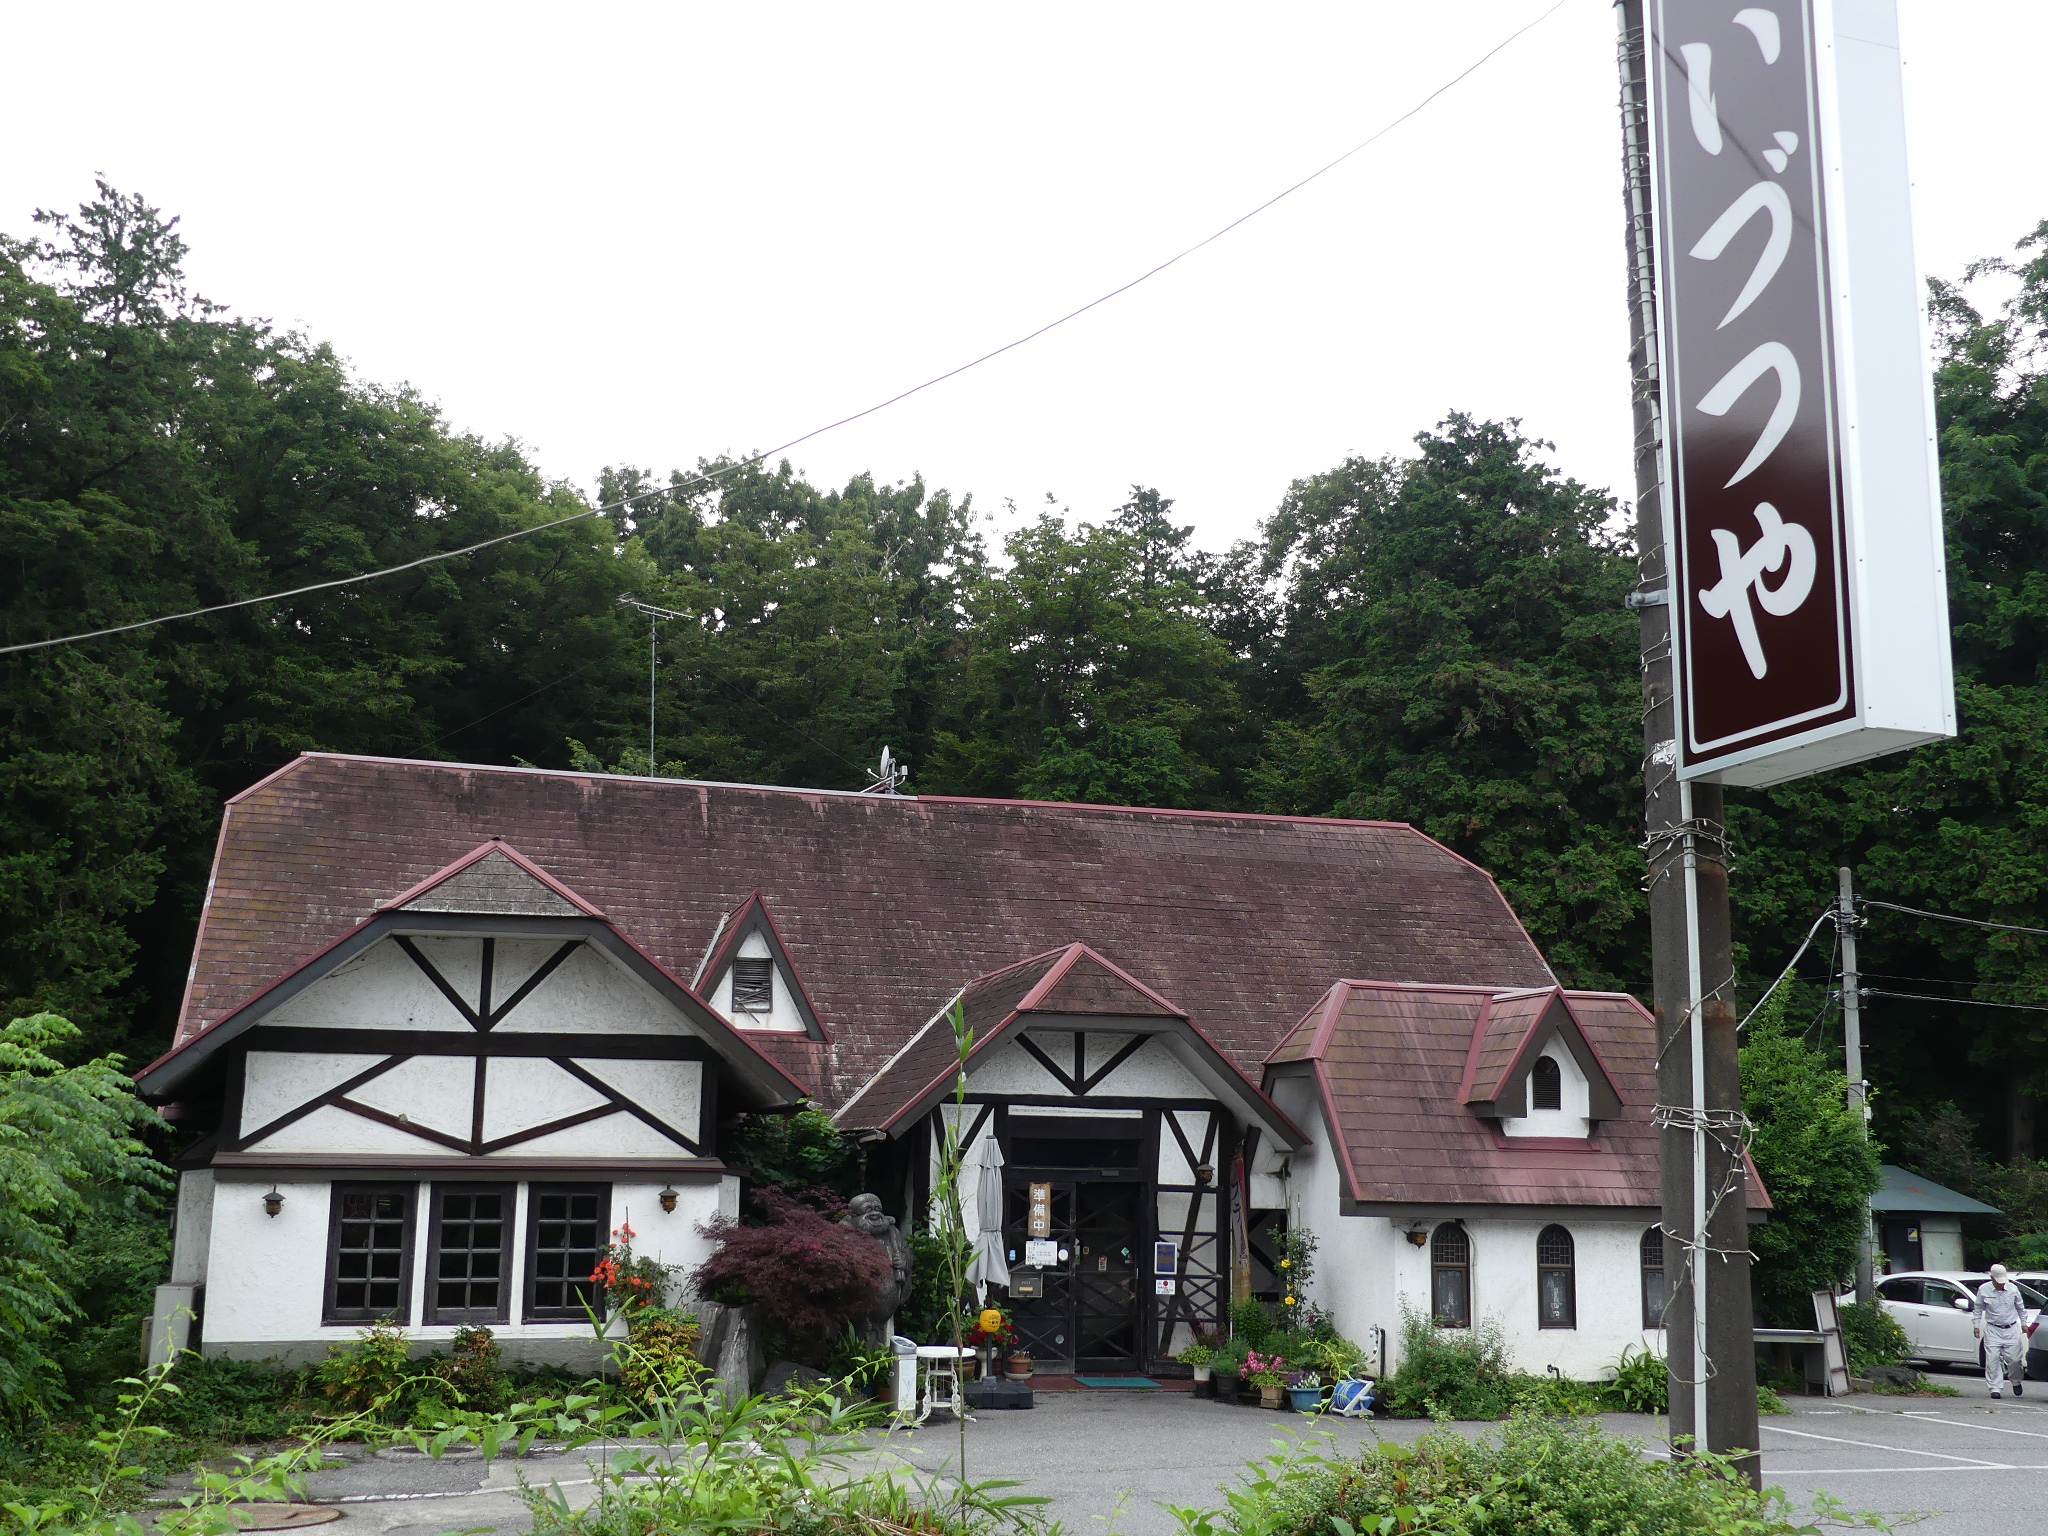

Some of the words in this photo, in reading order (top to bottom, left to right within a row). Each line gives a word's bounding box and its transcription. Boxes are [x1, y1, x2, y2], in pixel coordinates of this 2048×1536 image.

[1679, 7, 1817, 681] いづつや
[1033, 1188, 1045, 1231] 準備中
